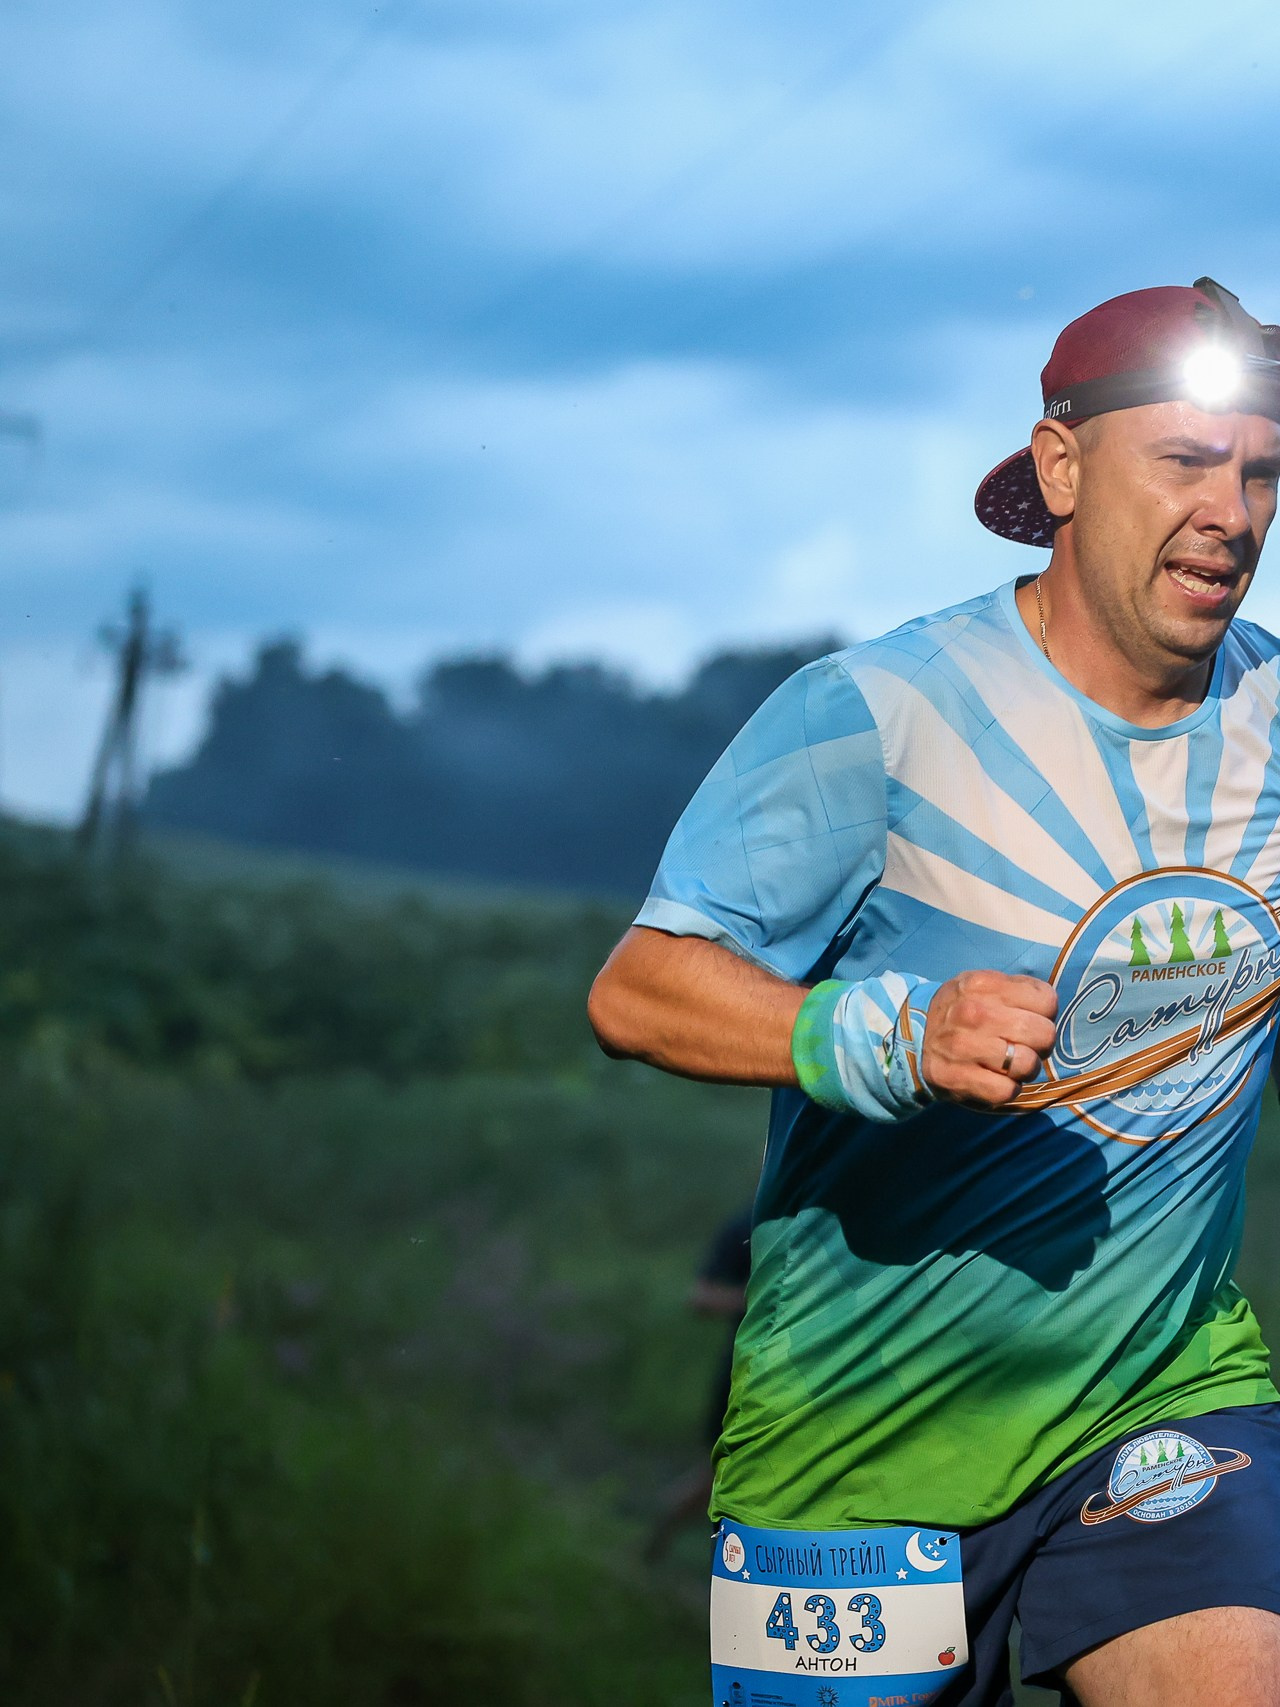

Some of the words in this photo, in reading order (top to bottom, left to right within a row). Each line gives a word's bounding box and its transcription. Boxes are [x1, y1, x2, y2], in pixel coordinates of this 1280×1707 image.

[1131, 961, 1226, 983] РАМЕНСКОЕ
[1119, 1446, 1134, 1464] КЛУБ
[1142, 1457, 1184, 1473] РАМЕНСКОЕ
[1132, 1509, 1166, 1519] ОСНОВАН
[755, 1542, 822, 1576] СЫРНЫЙ
[828, 1540, 887, 1576] ТРЕЙЛ
[765, 1592, 886, 1653] 433
[795, 1656, 857, 1672] АНТОН
